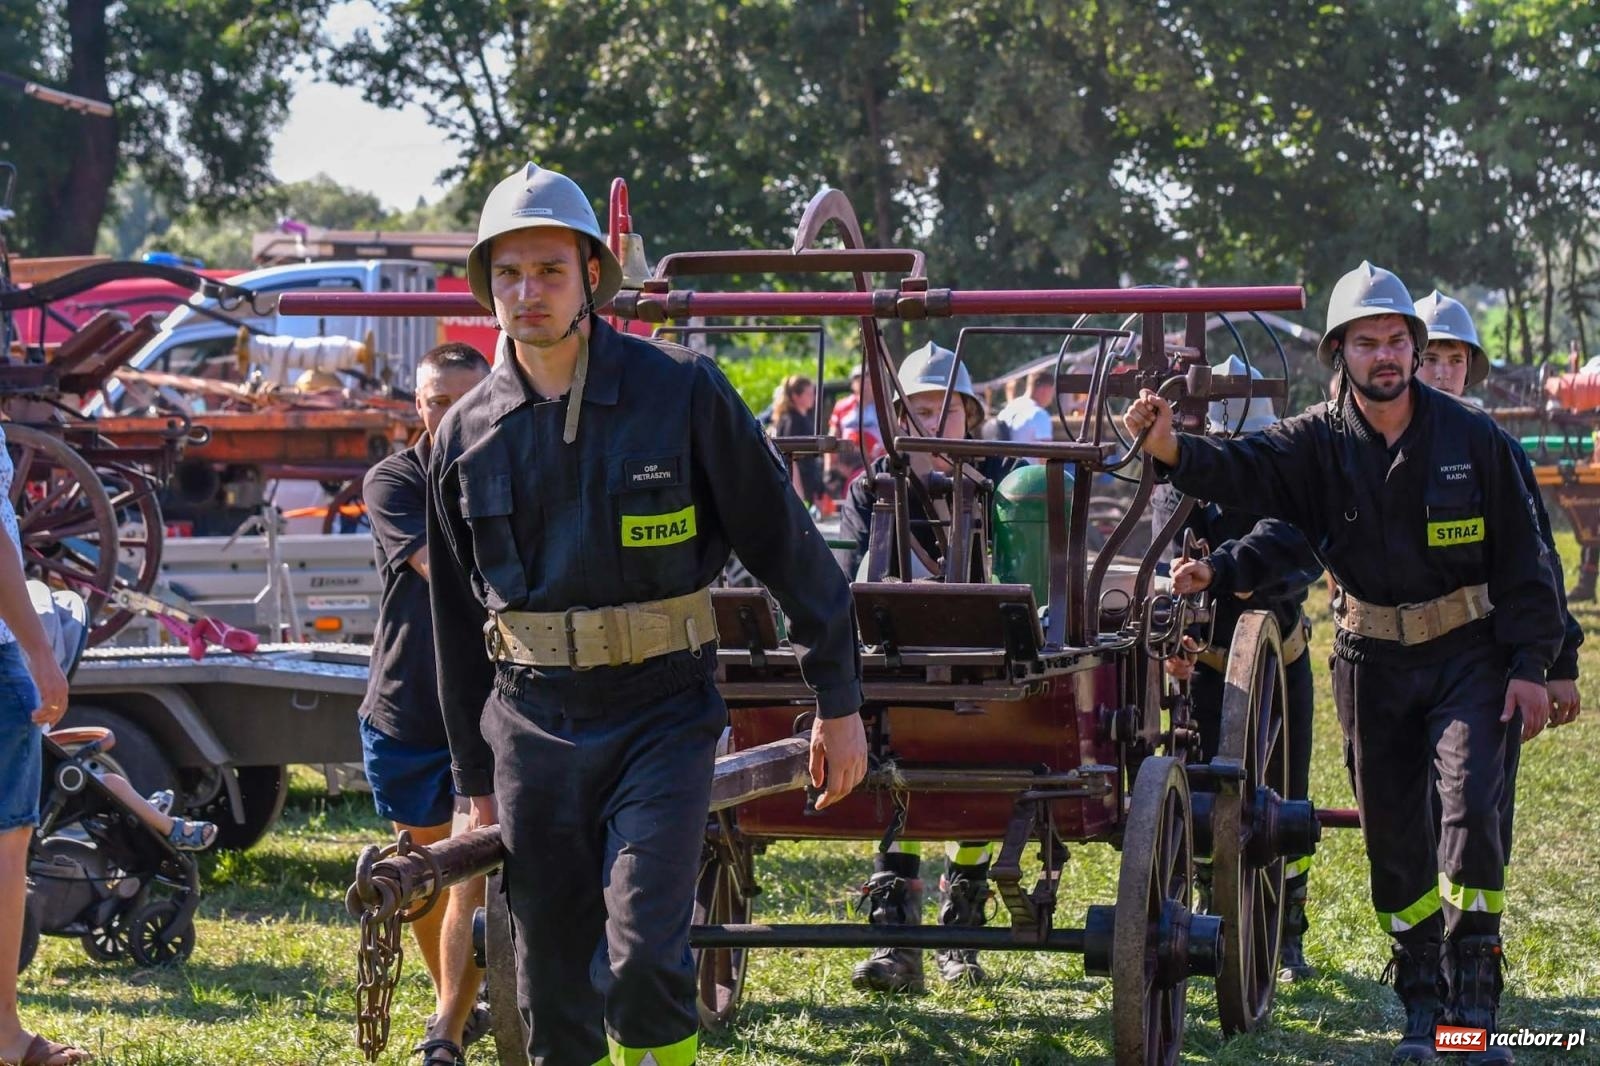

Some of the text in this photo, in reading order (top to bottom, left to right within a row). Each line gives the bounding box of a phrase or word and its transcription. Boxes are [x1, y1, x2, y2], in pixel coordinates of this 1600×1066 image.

[644, 464, 658, 473] OSP
[1440, 463, 1472, 472] KRYSTIAN
[632, 471, 671, 481] PIETRASZYN
